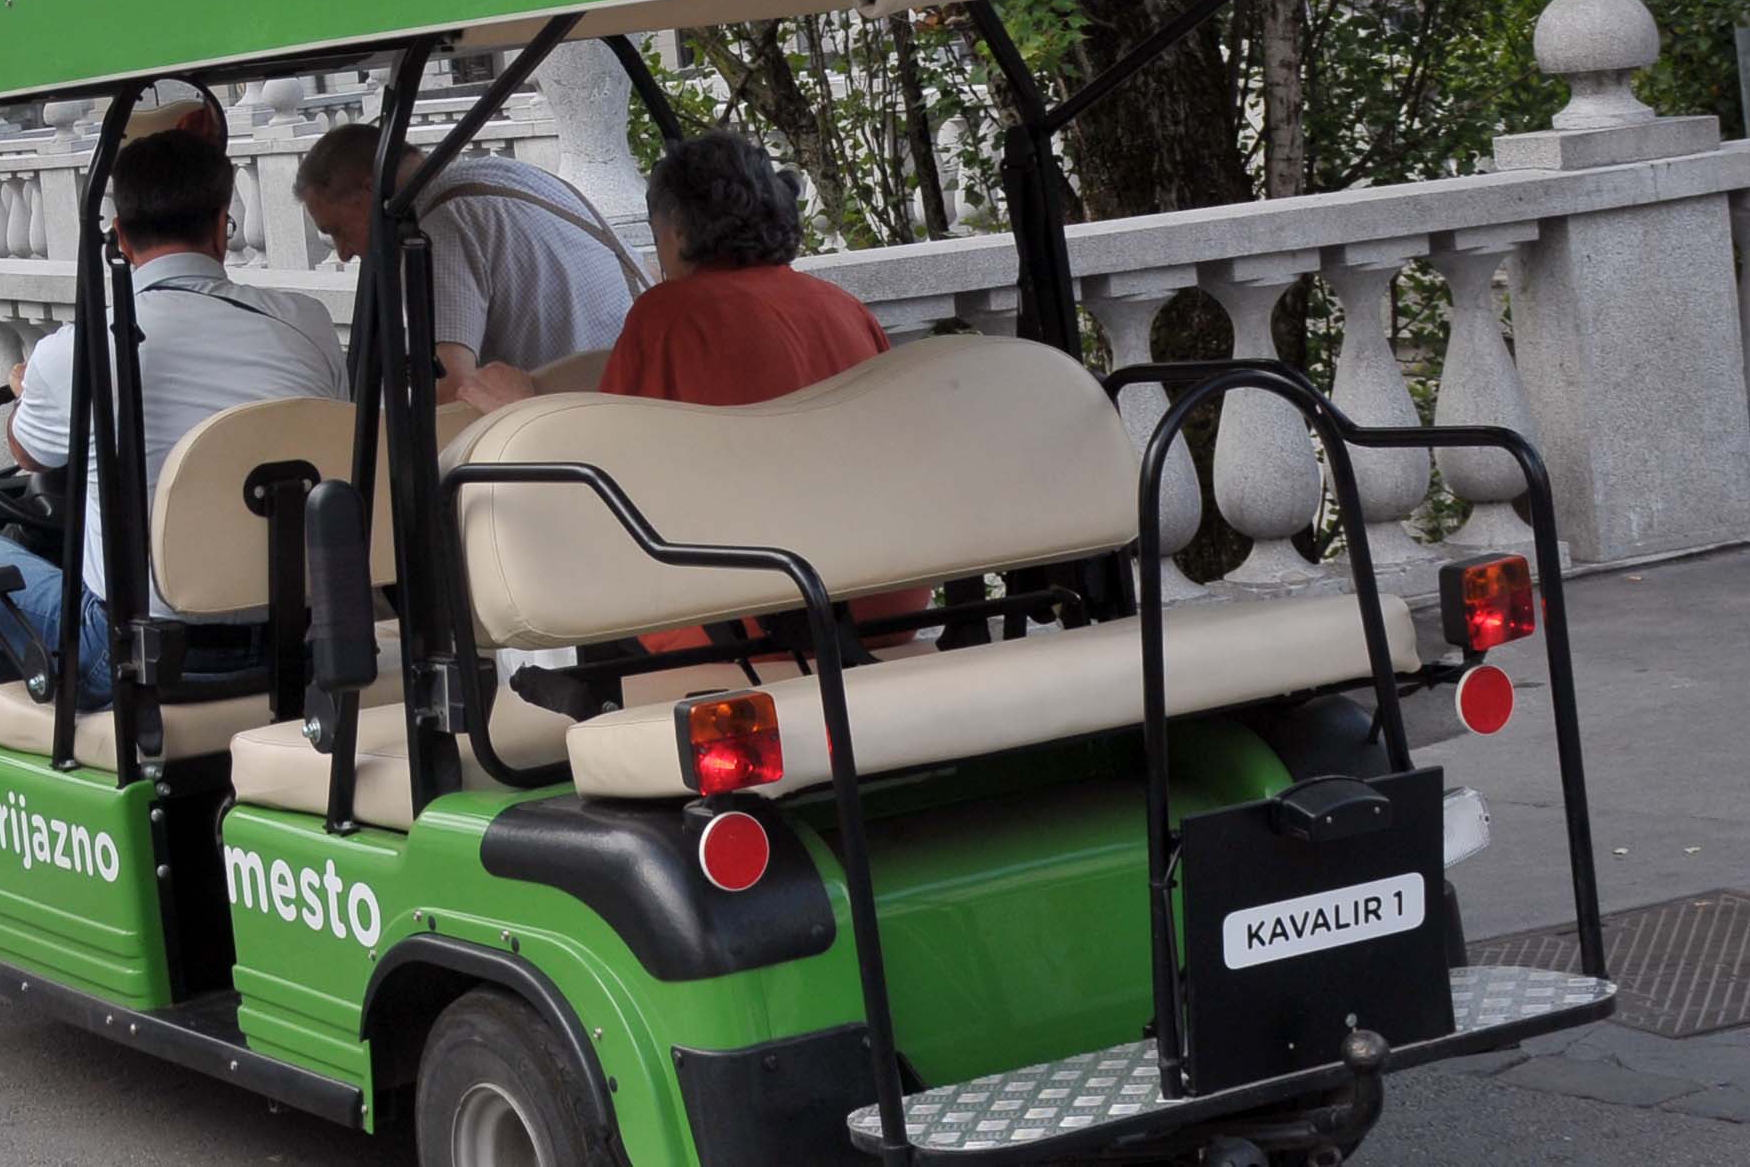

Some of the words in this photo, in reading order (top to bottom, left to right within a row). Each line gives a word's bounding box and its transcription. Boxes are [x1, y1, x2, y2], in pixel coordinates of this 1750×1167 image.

[224, 844, 381, 948] mesto
[1246, 896, 1383, 950] KAVALIR
[1393, 890, 1403, 917] 1
